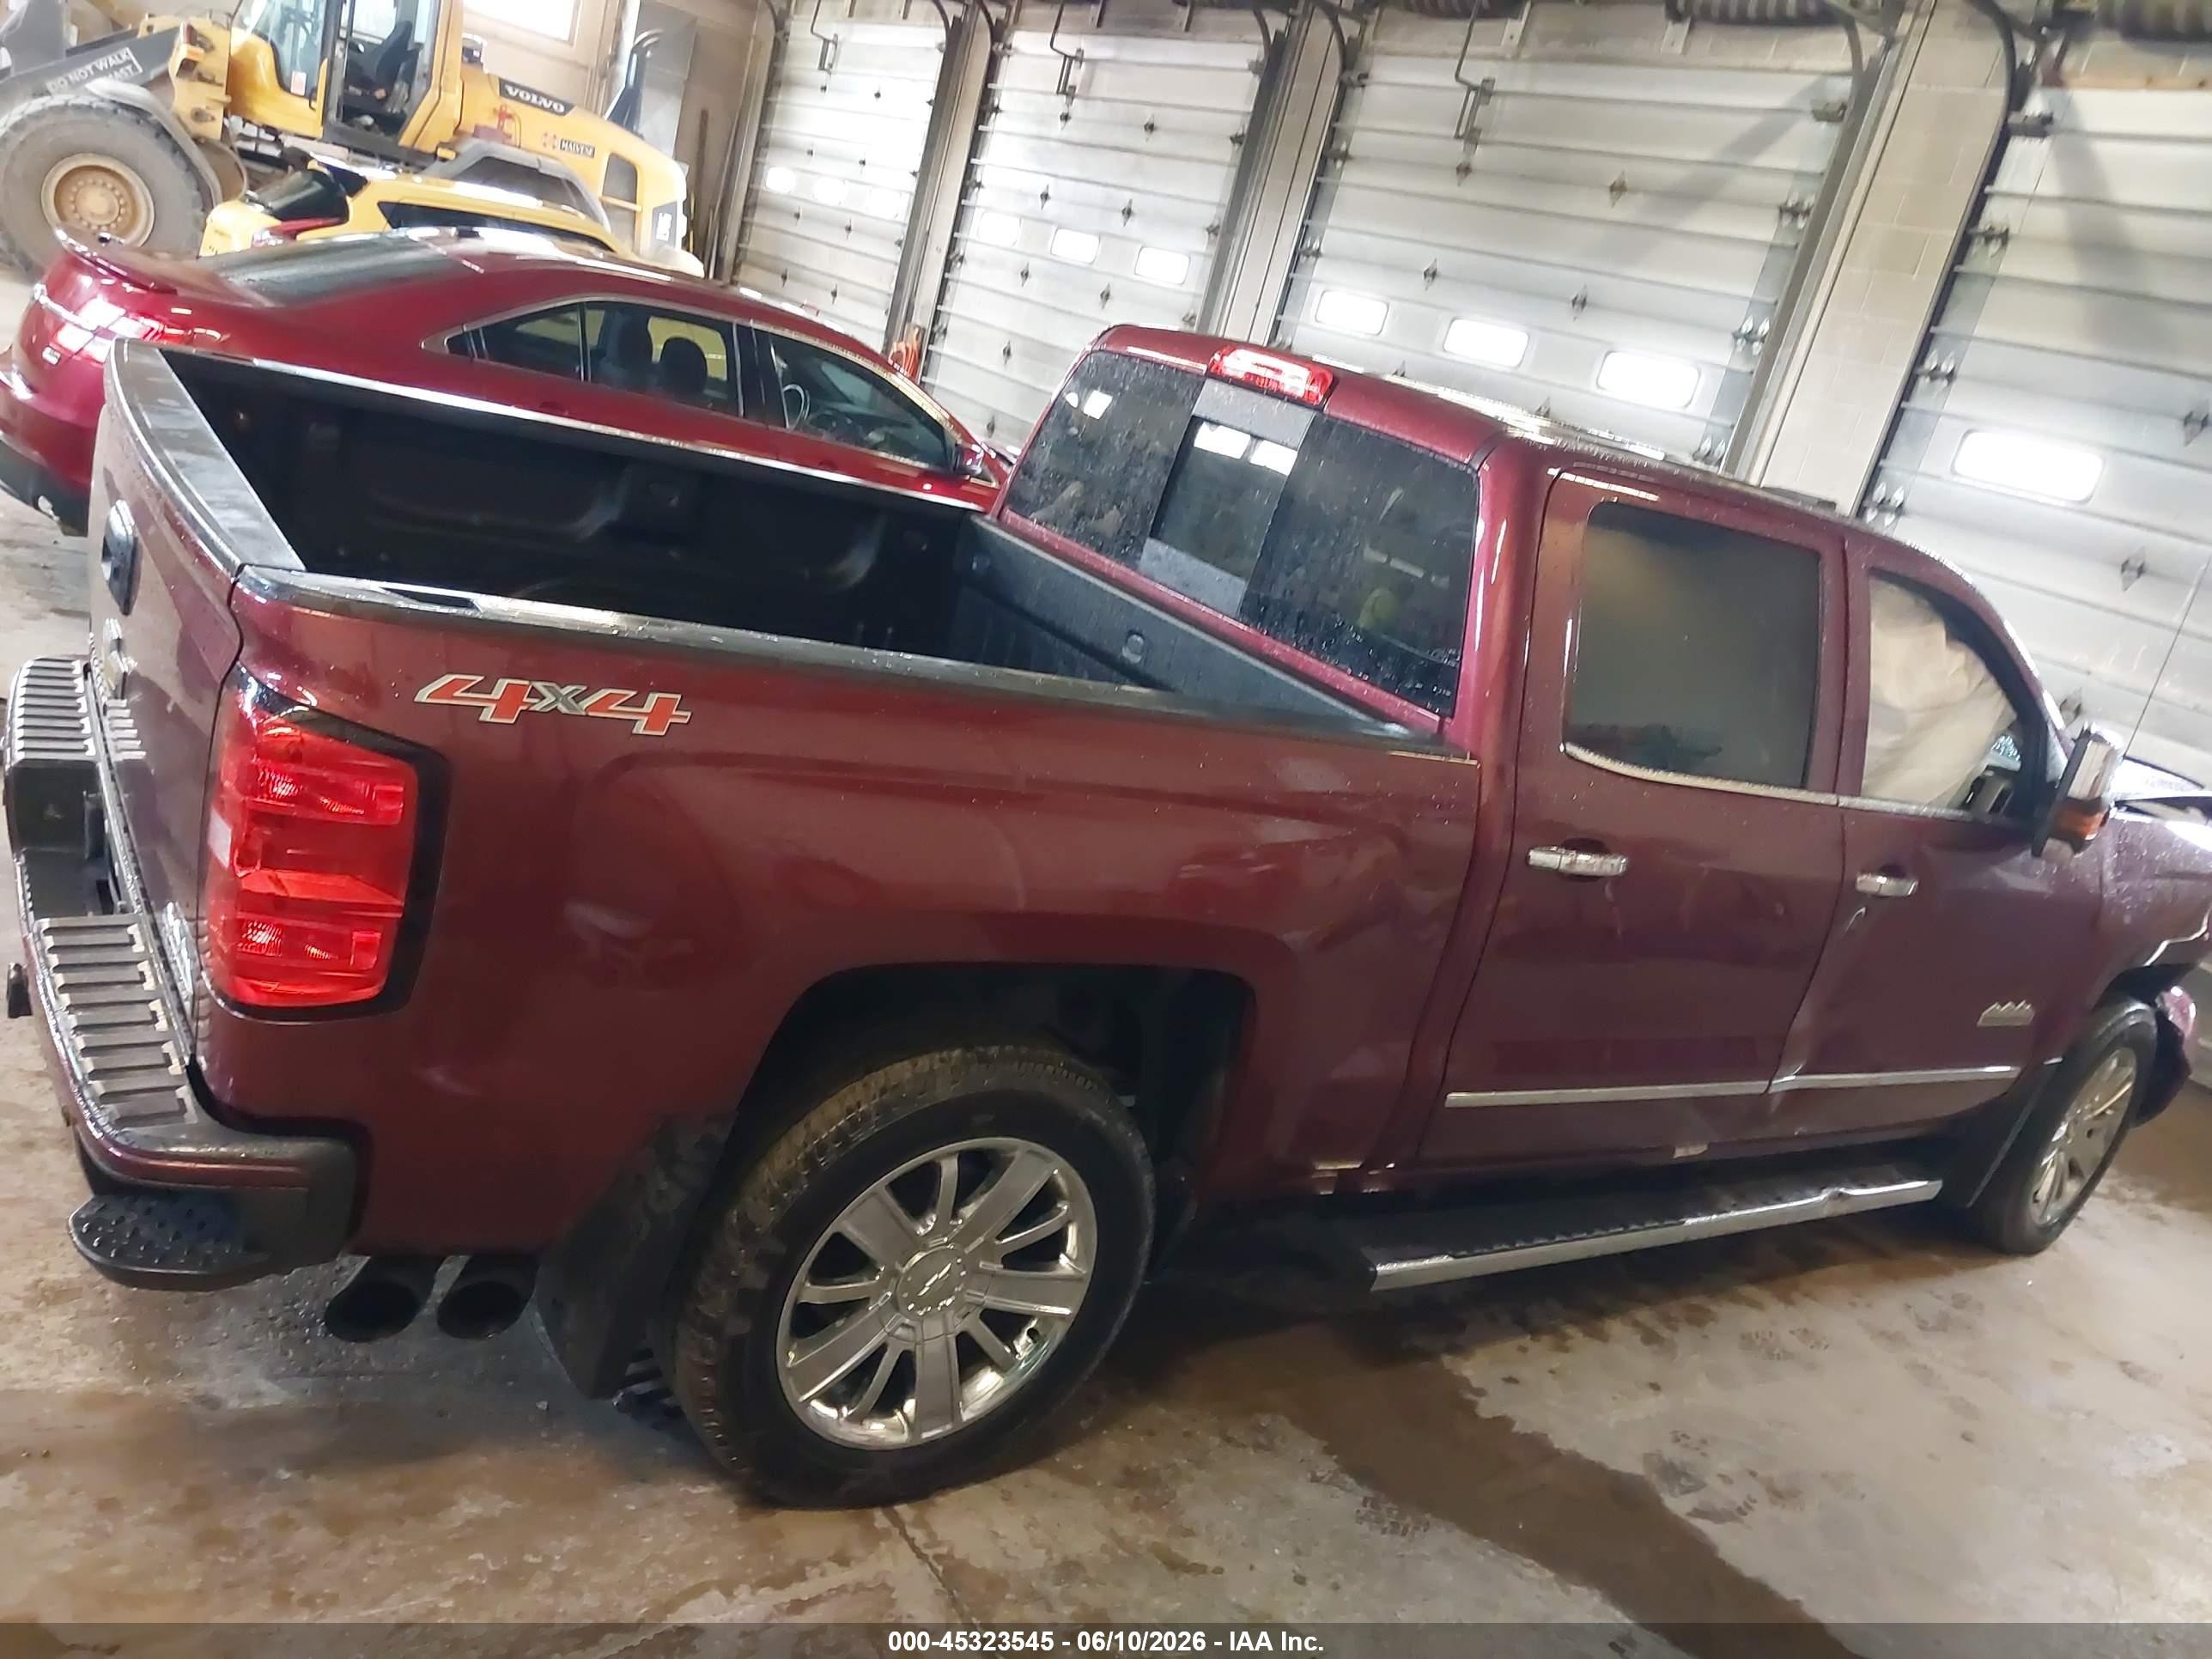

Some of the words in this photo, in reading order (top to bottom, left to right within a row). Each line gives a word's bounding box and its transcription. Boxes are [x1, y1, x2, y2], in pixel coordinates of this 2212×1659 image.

[68, 64, 94, 83] NOT
[94, 49, 132, 70] WALK
[505, 84, 565, 113] VOLVO
